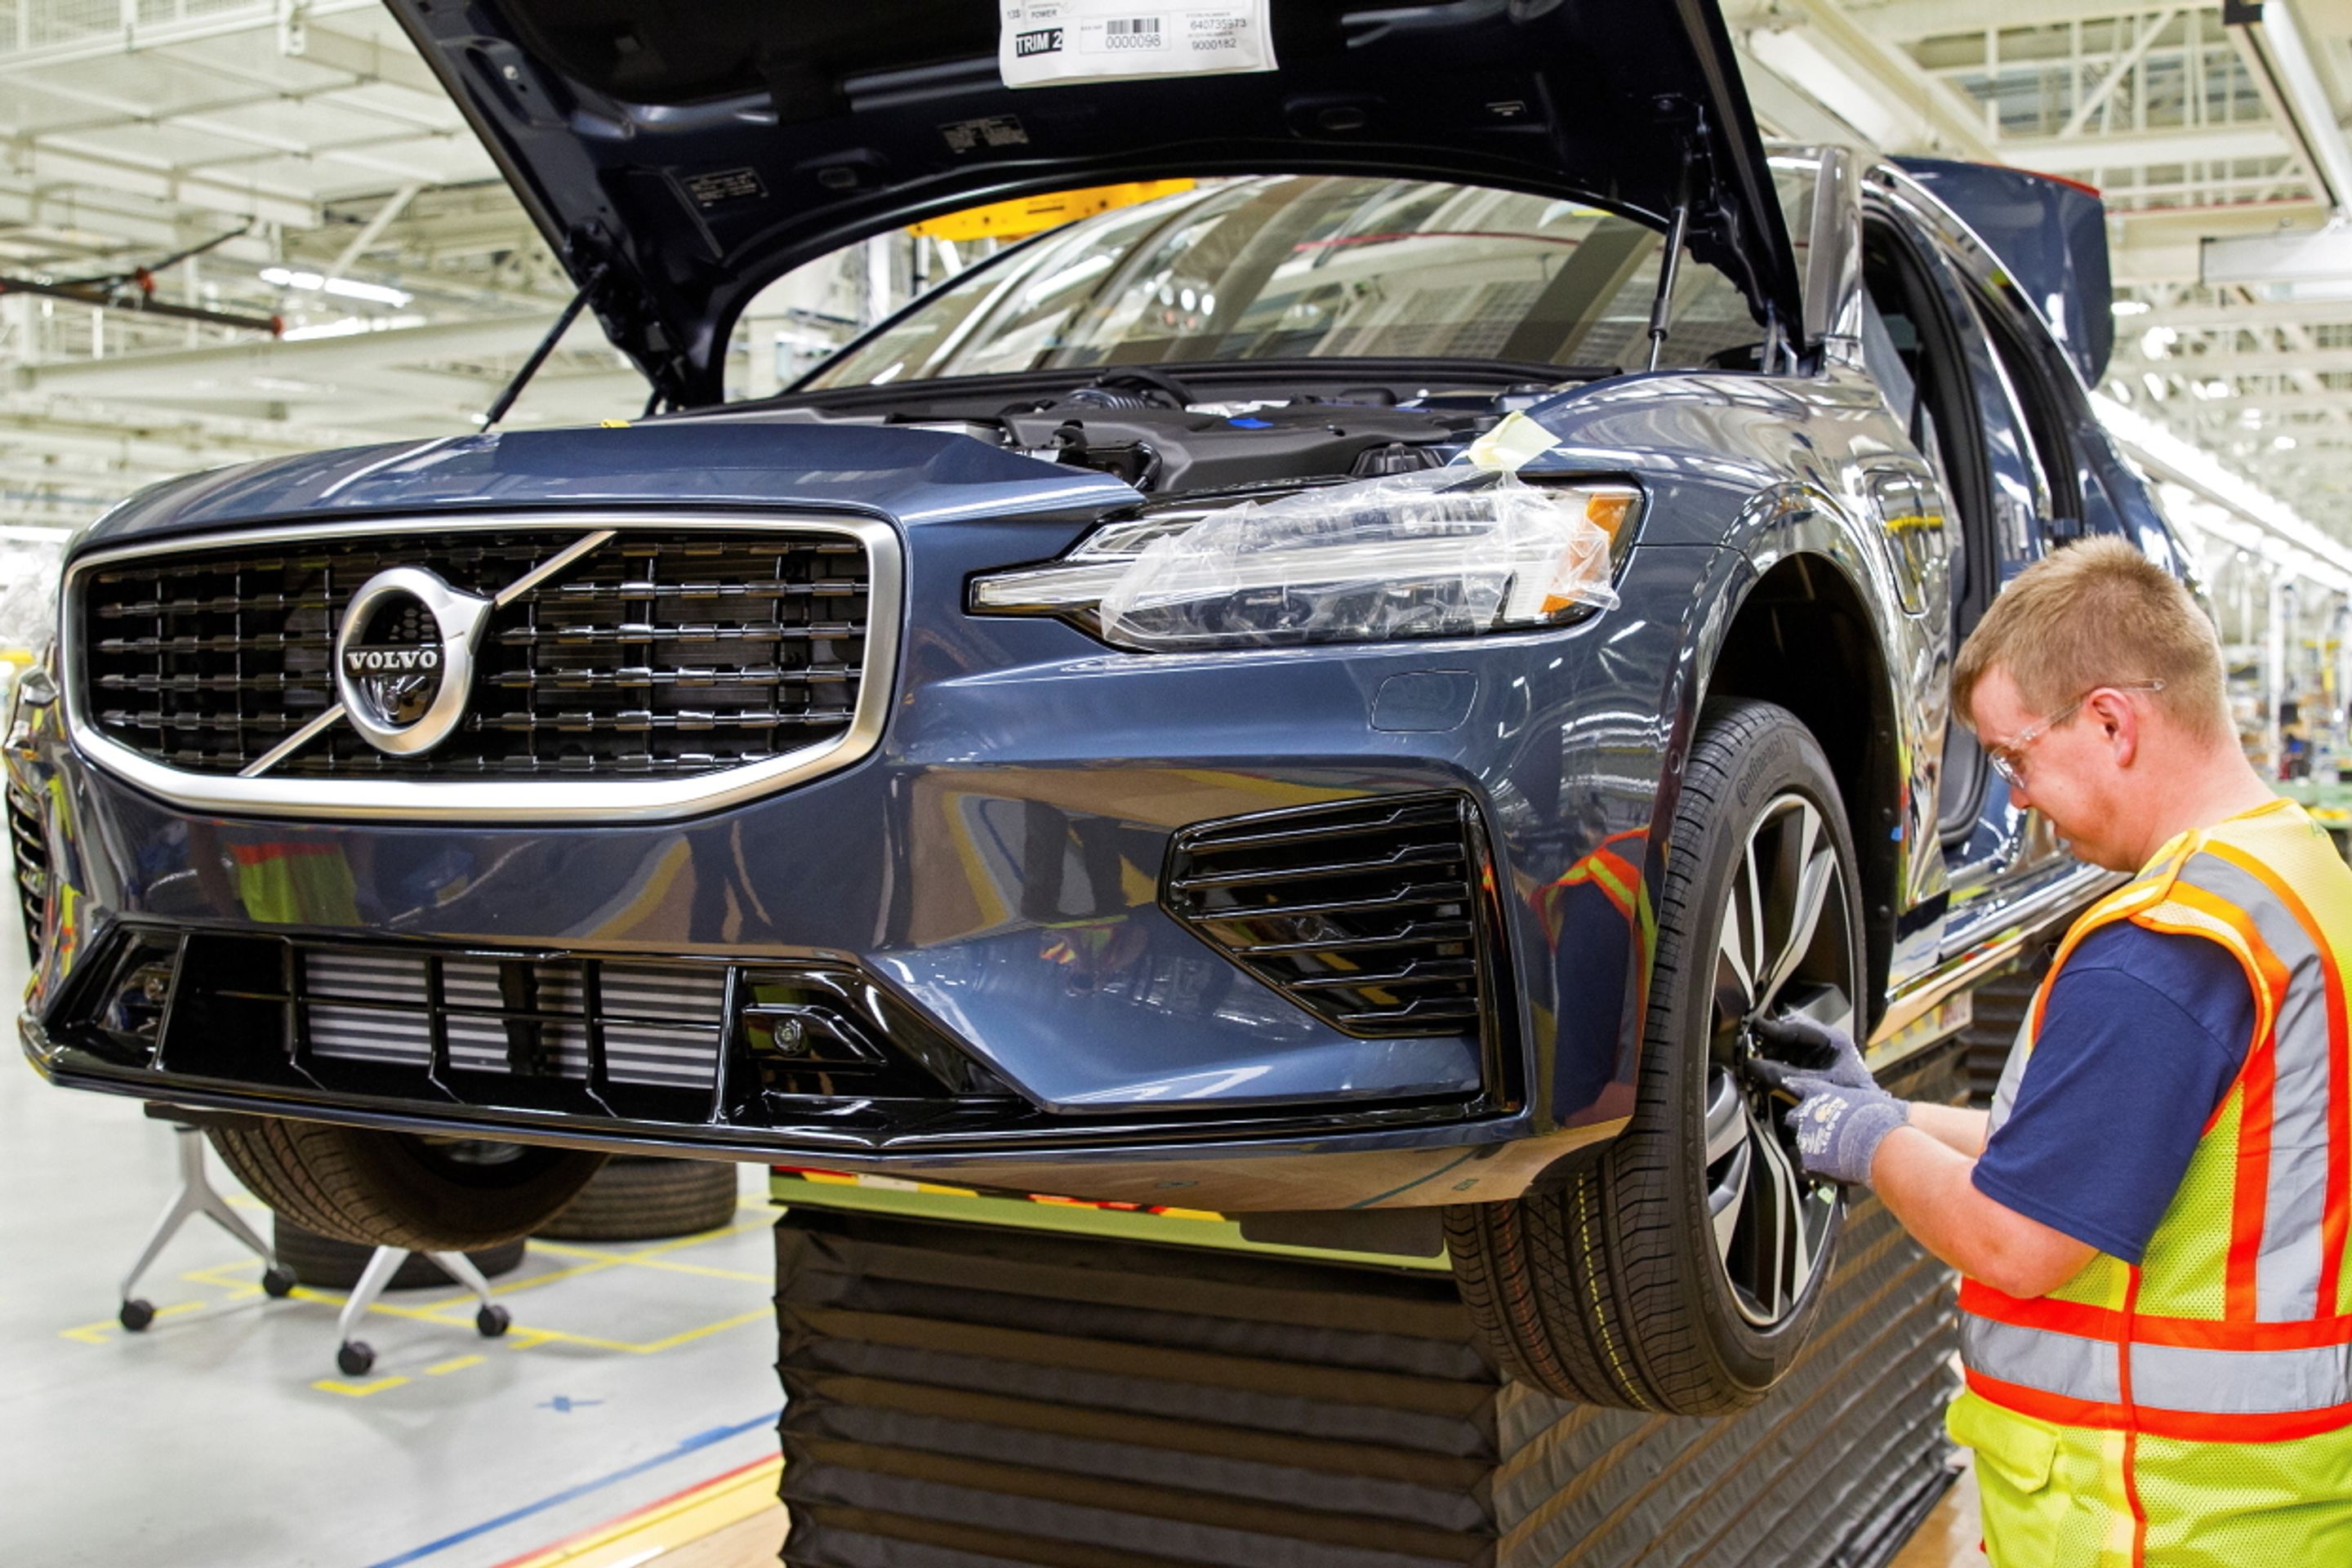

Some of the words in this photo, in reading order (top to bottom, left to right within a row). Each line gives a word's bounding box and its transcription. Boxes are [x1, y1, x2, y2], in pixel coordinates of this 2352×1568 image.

[1016, 33, 1049, 54] TRIM
[1052, 31, 1062, 49] 2
[1105, 34, 1160, 49] 0000098
[346, 650, 438, 670] VOLVO
